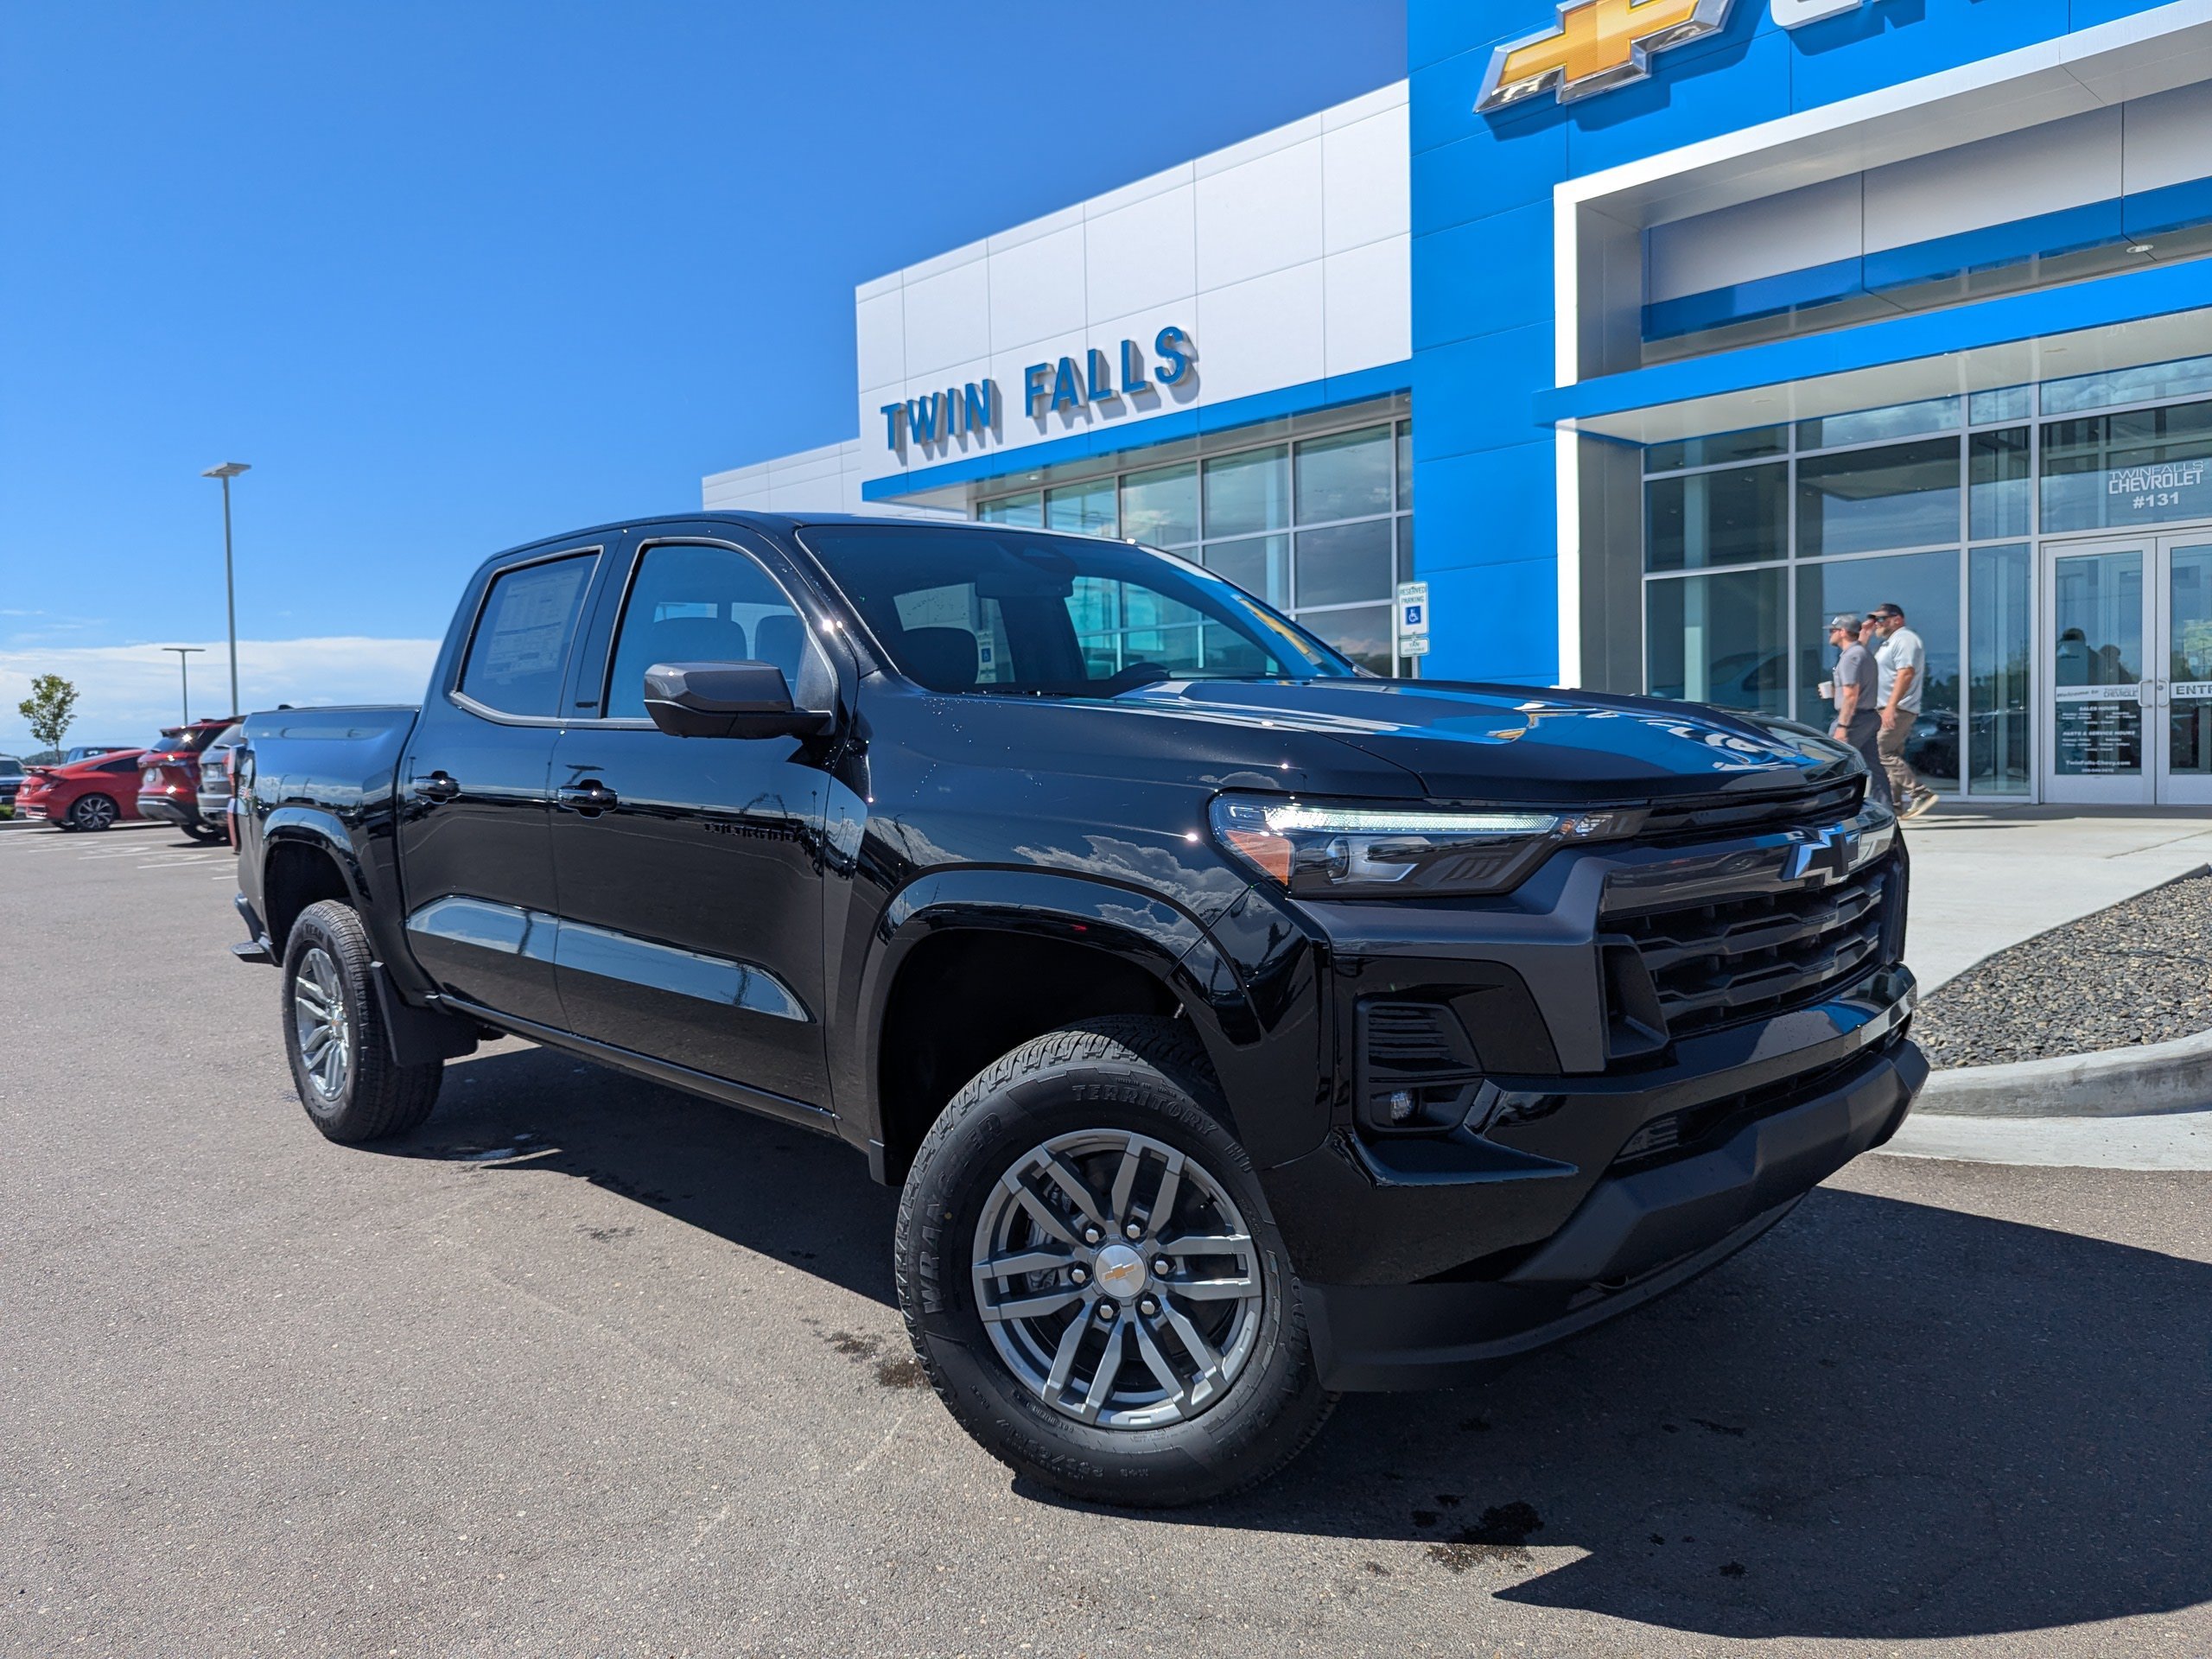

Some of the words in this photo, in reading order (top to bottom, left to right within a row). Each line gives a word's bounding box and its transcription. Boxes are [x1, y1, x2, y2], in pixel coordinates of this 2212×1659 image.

[880, 378, 995, 451] TWIN
[1024, 326, 1188, 418] FALLS
[2108, 470, 2204, 495] CHEVROLET
[2133, 492, 2179, 510] #131
[1072, 1084, 1219, 1137] TERRITORY
